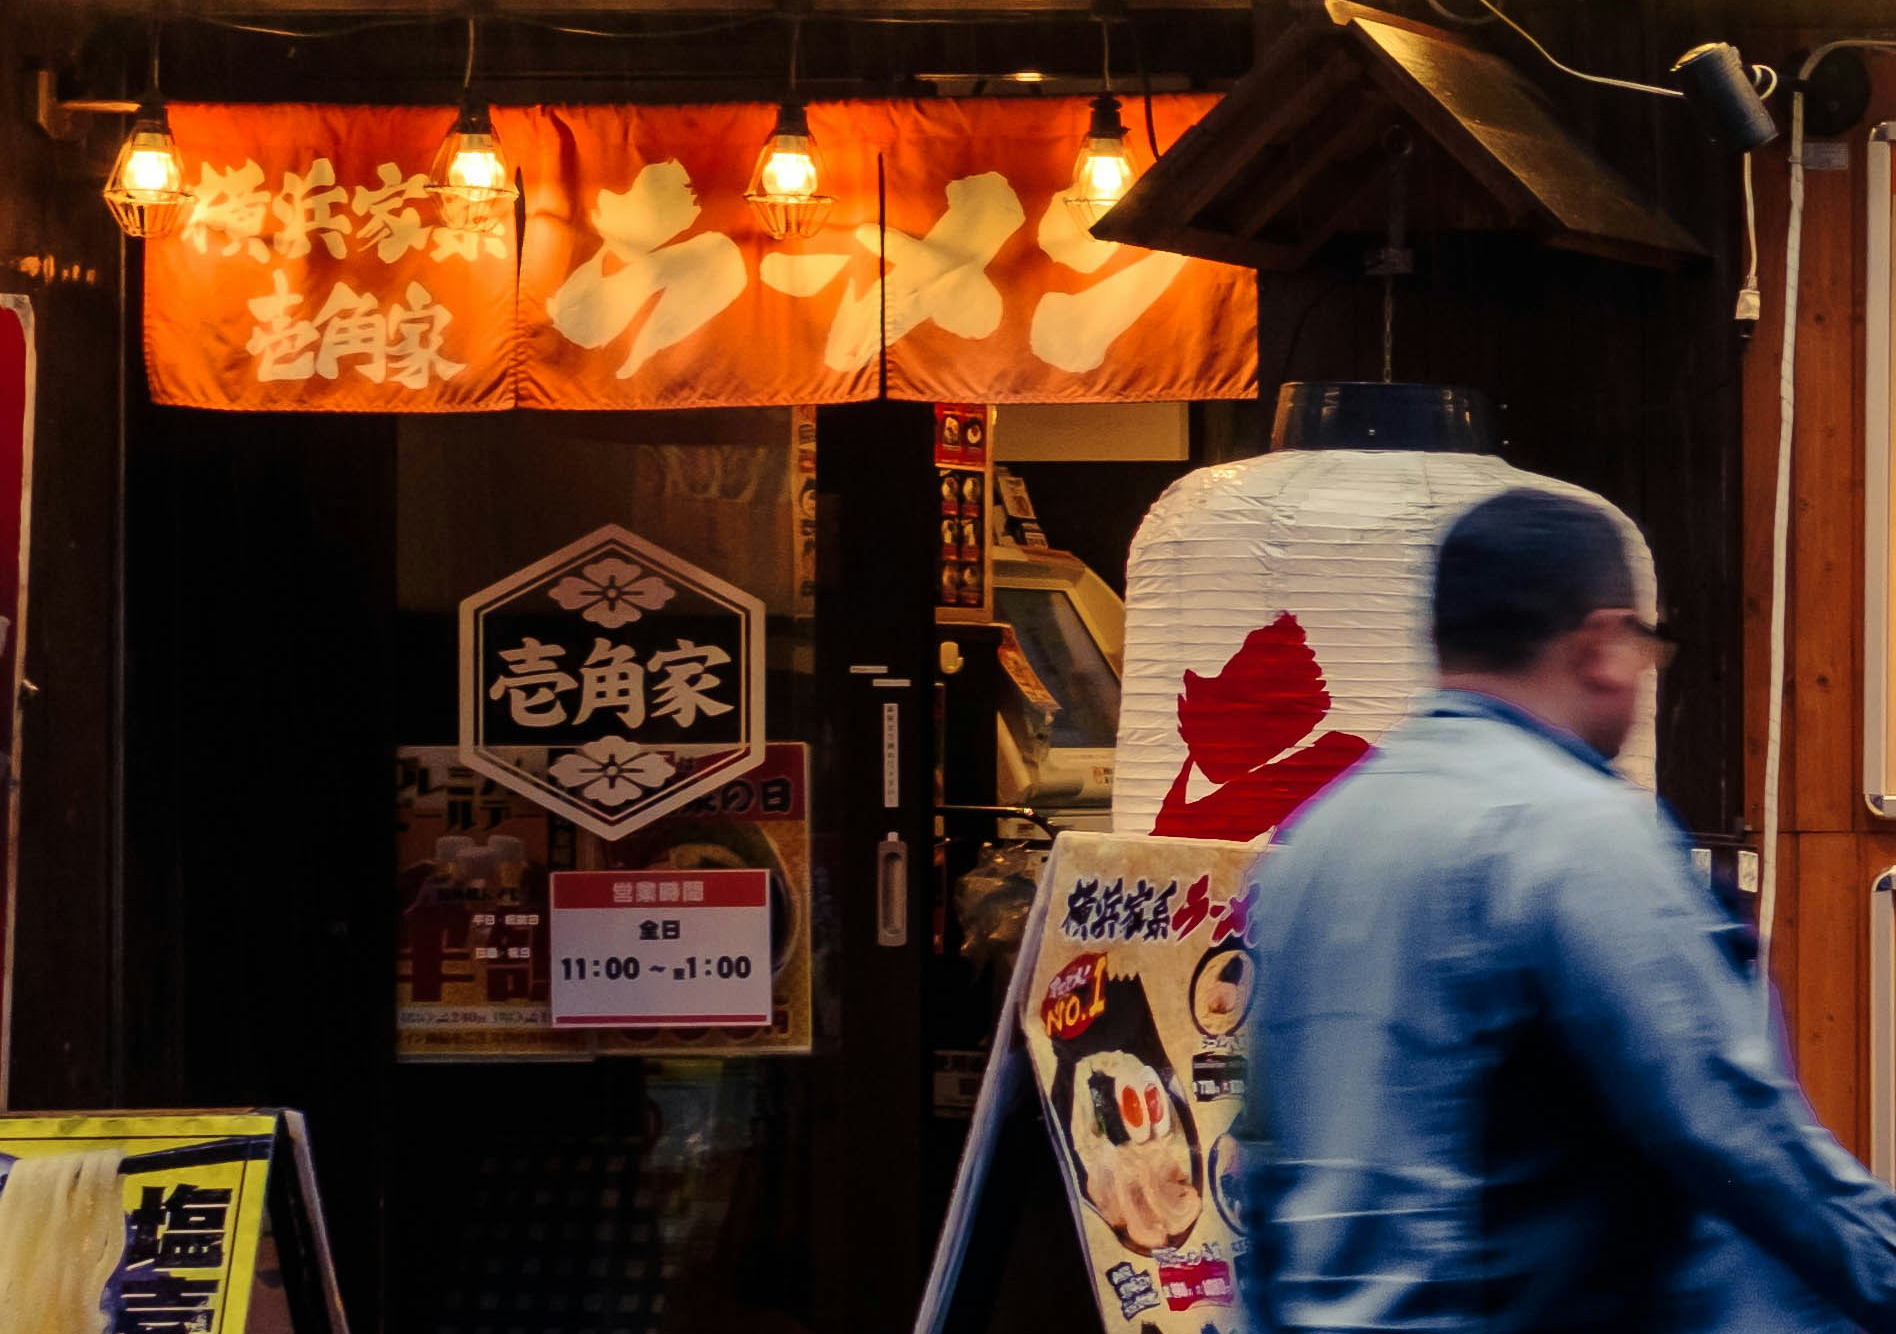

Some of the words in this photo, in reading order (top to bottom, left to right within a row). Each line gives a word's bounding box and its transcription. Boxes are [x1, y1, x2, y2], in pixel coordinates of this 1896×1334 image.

[548, 158, 1190, 378] ラーメン
[247, 270, 466, 389] 壱角家
[488, 637, 735, 729] 壱角家
[638, 919, 681, 941] 全日
